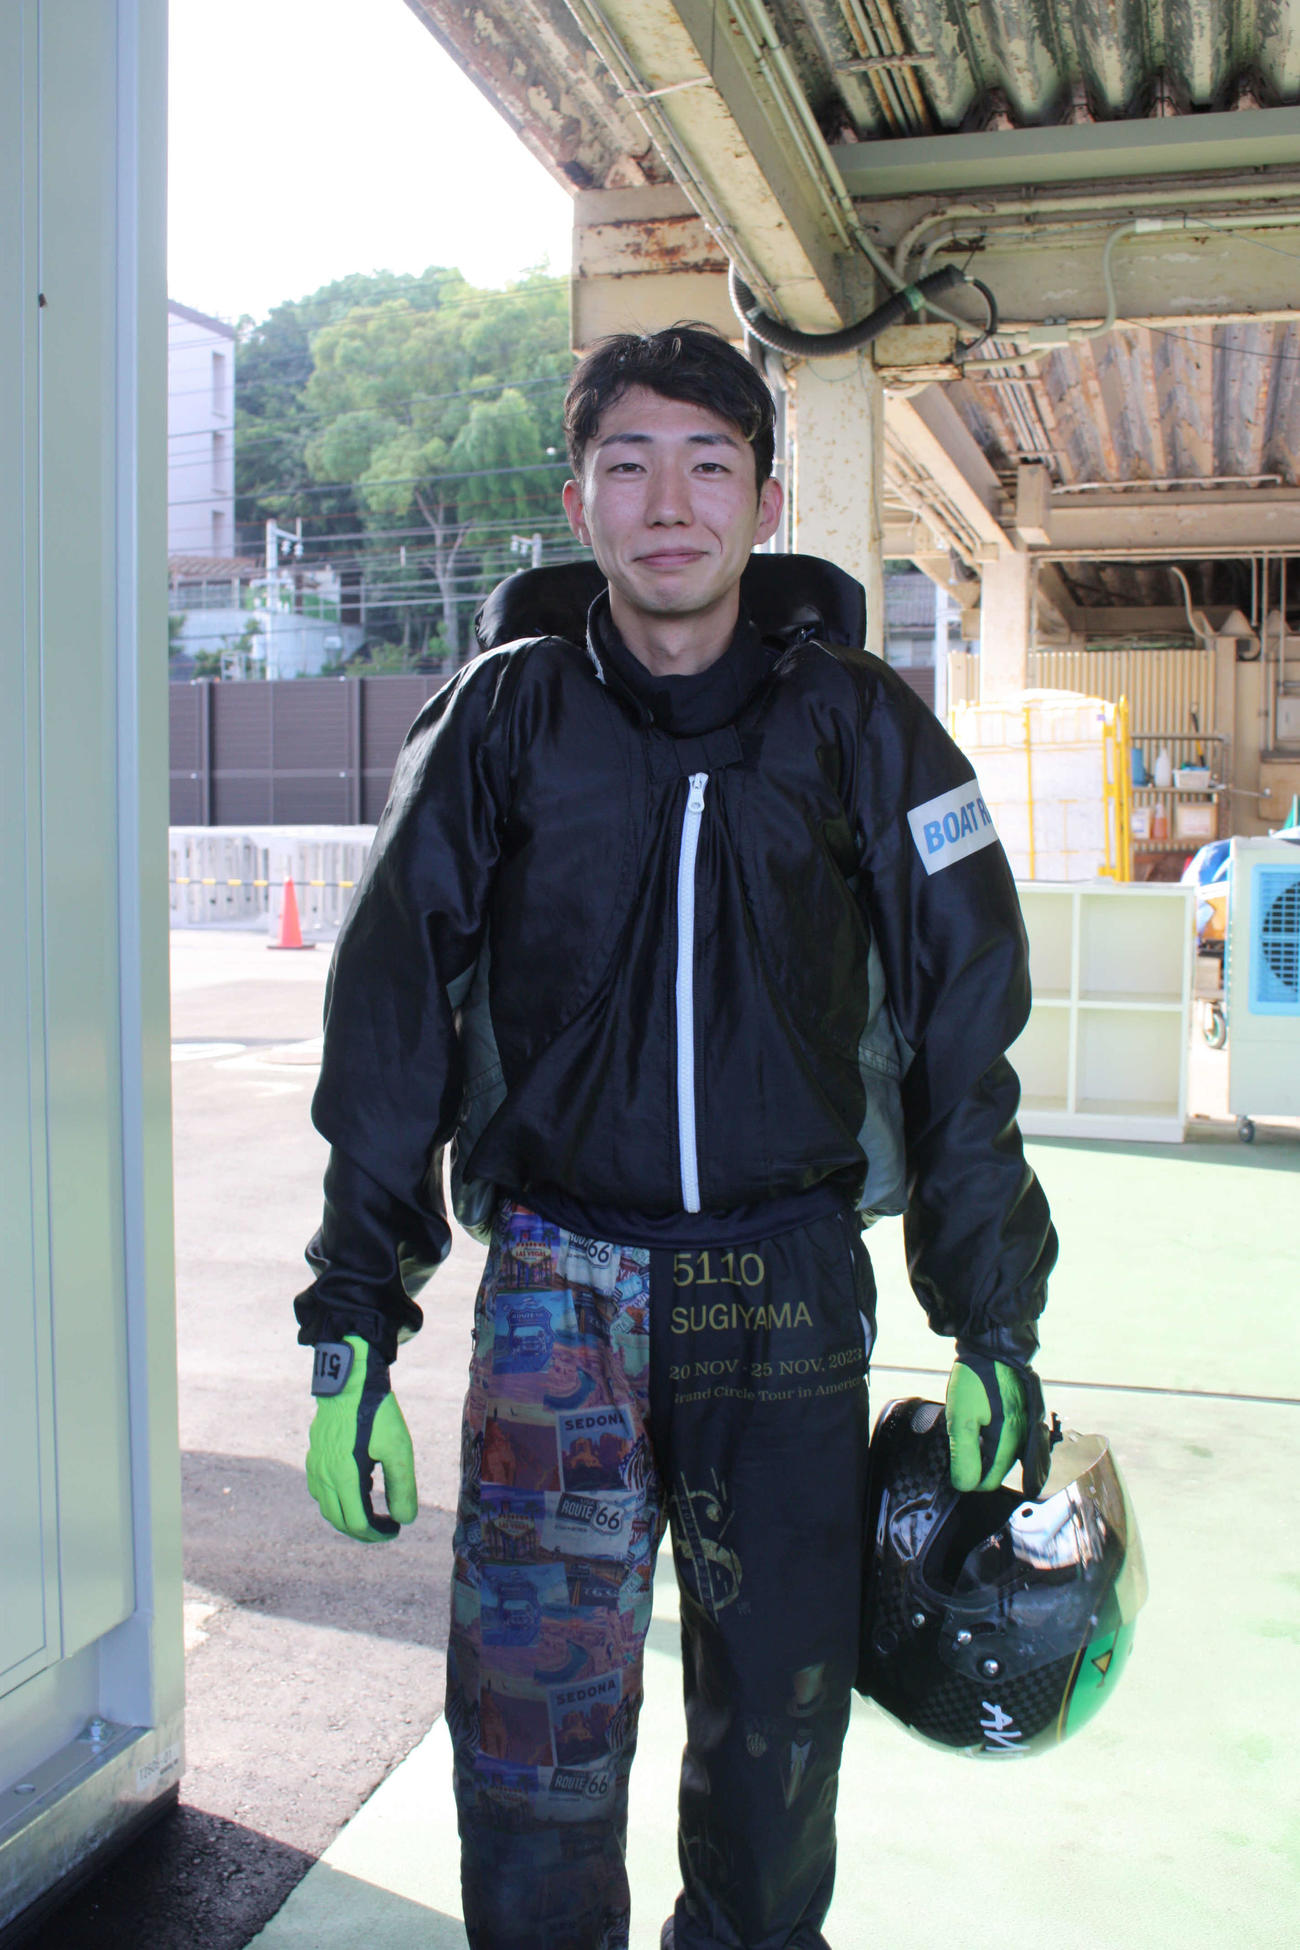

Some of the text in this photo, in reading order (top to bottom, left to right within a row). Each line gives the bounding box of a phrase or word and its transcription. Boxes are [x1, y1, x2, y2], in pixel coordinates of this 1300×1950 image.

[923, 801, 978, 854] BOAT
[588, 1239, 610, 1263] 66
[672, 1251, 765, 1287] 5110
[670, 1302, 813, 1334] SUGIYAMA
[669, 1364, 690, 1380] 20
[694, 1359, 739, 1376] NOV
[751, 1362, 773, 1377] 25
[757, 1389, 794, 1401] Tour
[799, 1388, 812, 1398] in
[561, 1498, 621, 1530] ROUTE 66
[556, 1679, 617, 1706] SEDONA
[587, 1773, 609, 1794] 66
